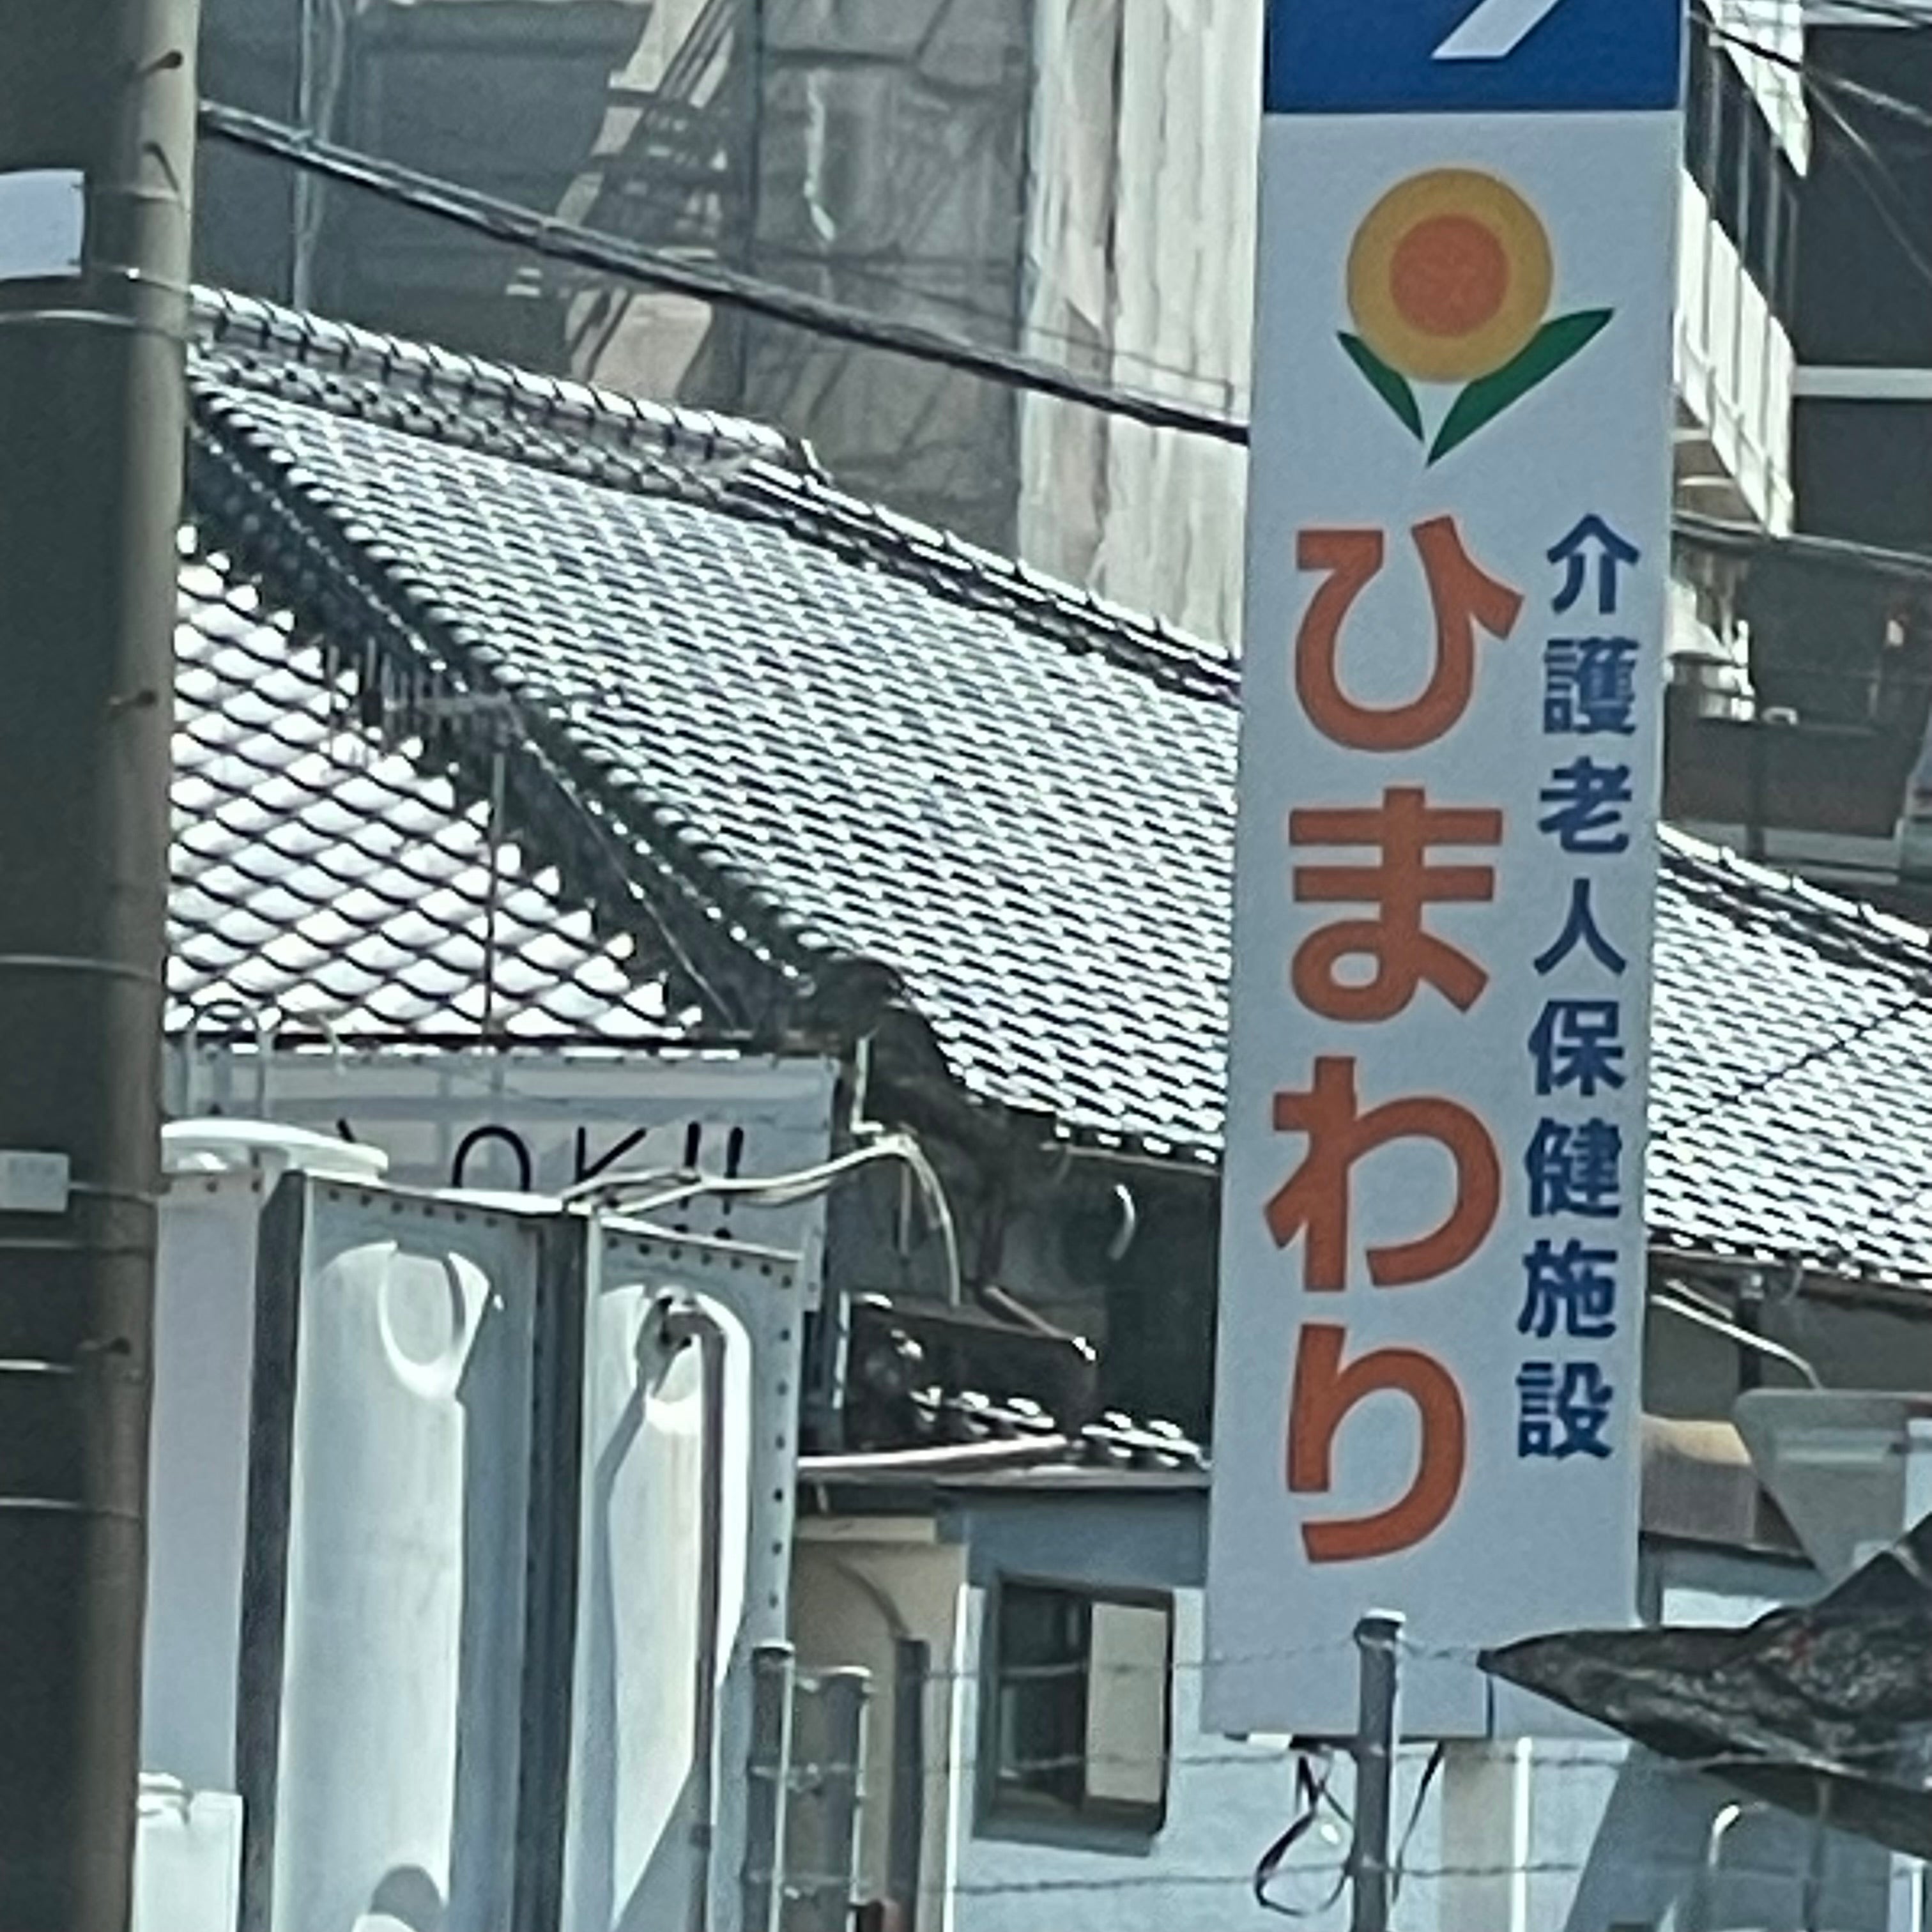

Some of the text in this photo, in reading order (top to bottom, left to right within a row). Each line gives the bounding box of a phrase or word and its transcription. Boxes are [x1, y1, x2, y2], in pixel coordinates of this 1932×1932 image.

[1264, 515, 1524, 1563] ひまわり
[1516, 514, 1640, 1460] 介護老人保健施設
